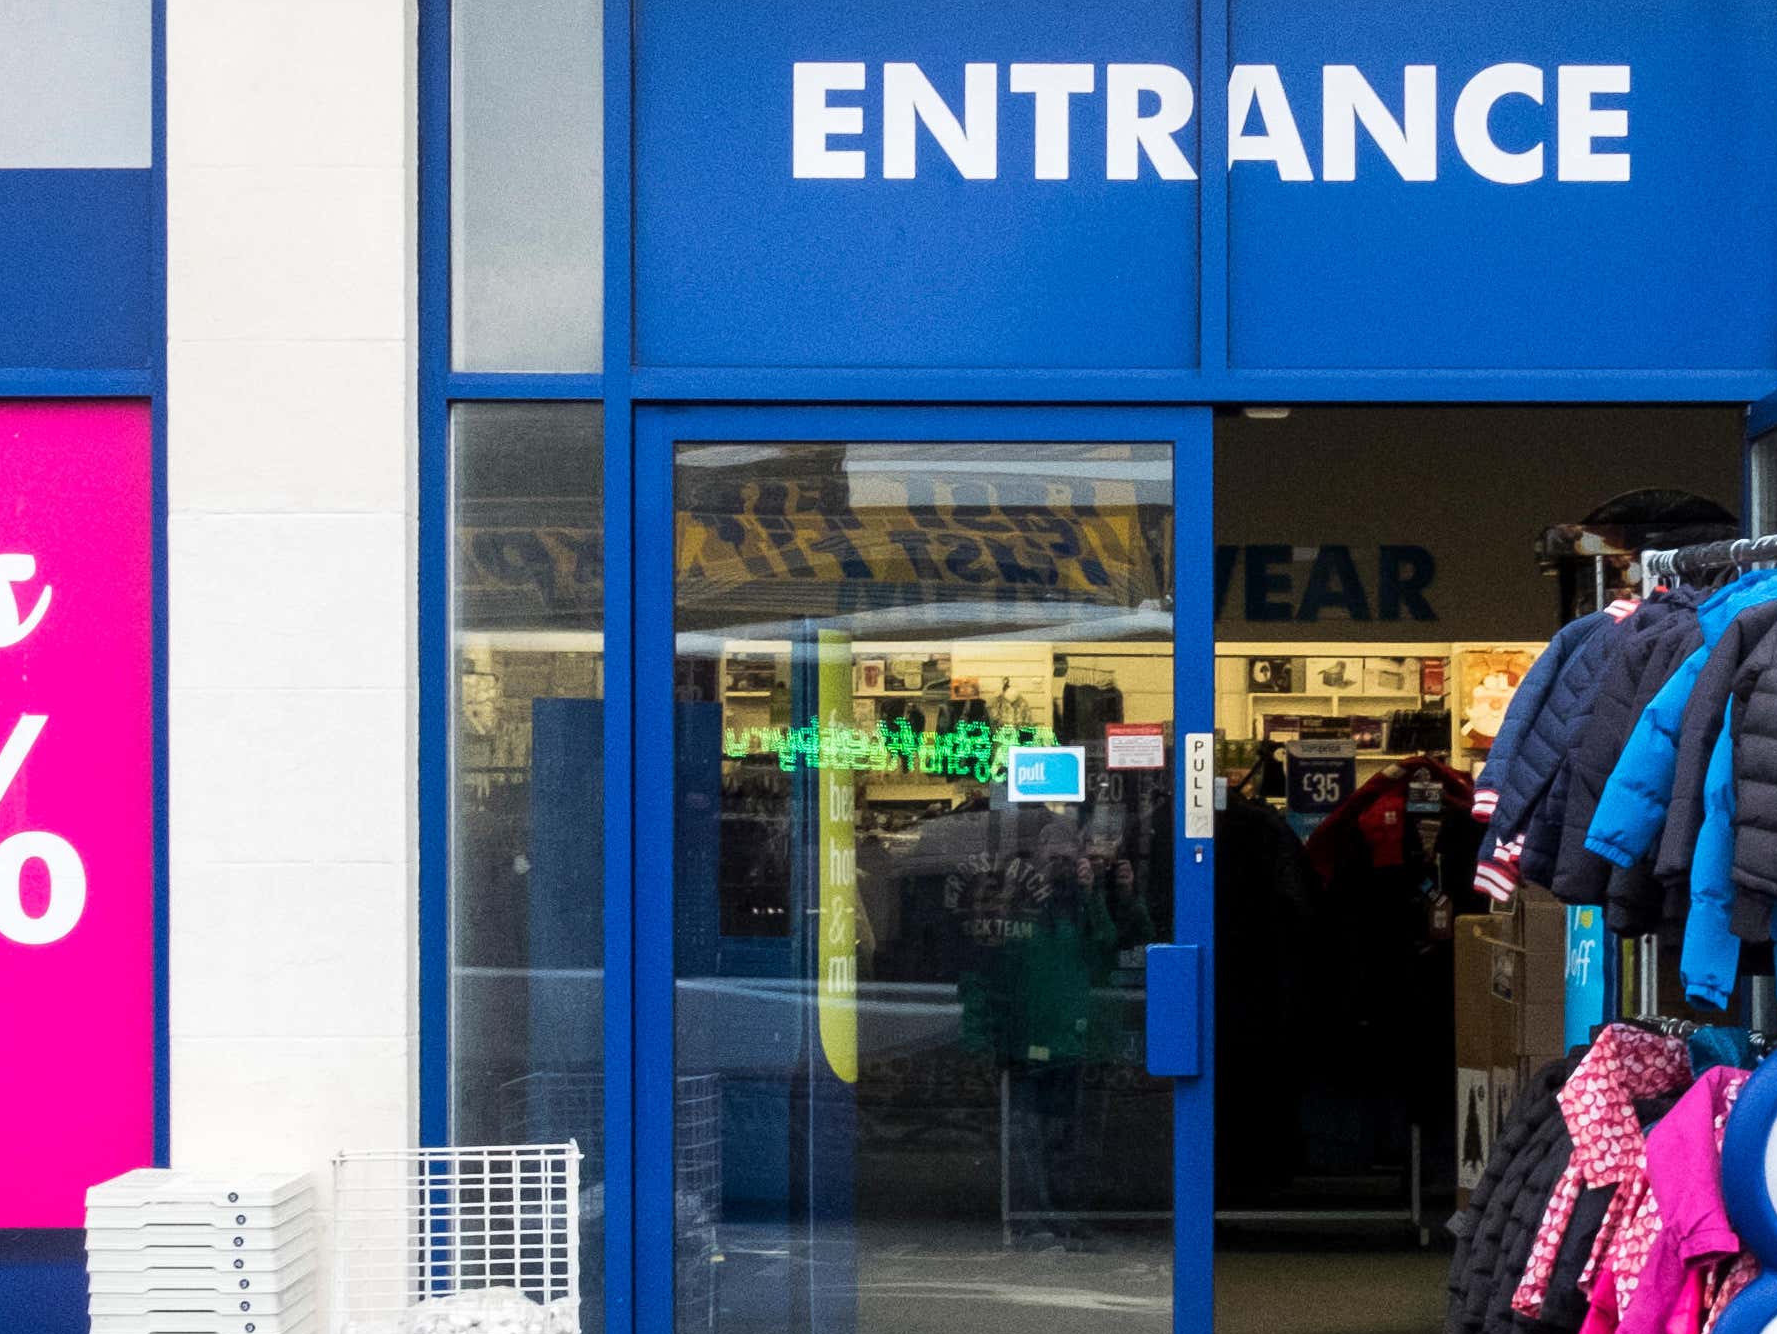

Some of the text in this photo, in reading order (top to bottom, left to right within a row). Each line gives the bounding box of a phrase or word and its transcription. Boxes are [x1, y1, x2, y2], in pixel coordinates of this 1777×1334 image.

[792, 62, 1631, 185] ENTRANCE
[1017, 762, 1046, 785] pull
[1193, 740, 1205, 808] PULL
[1303, 773, 1340, 802] £35
